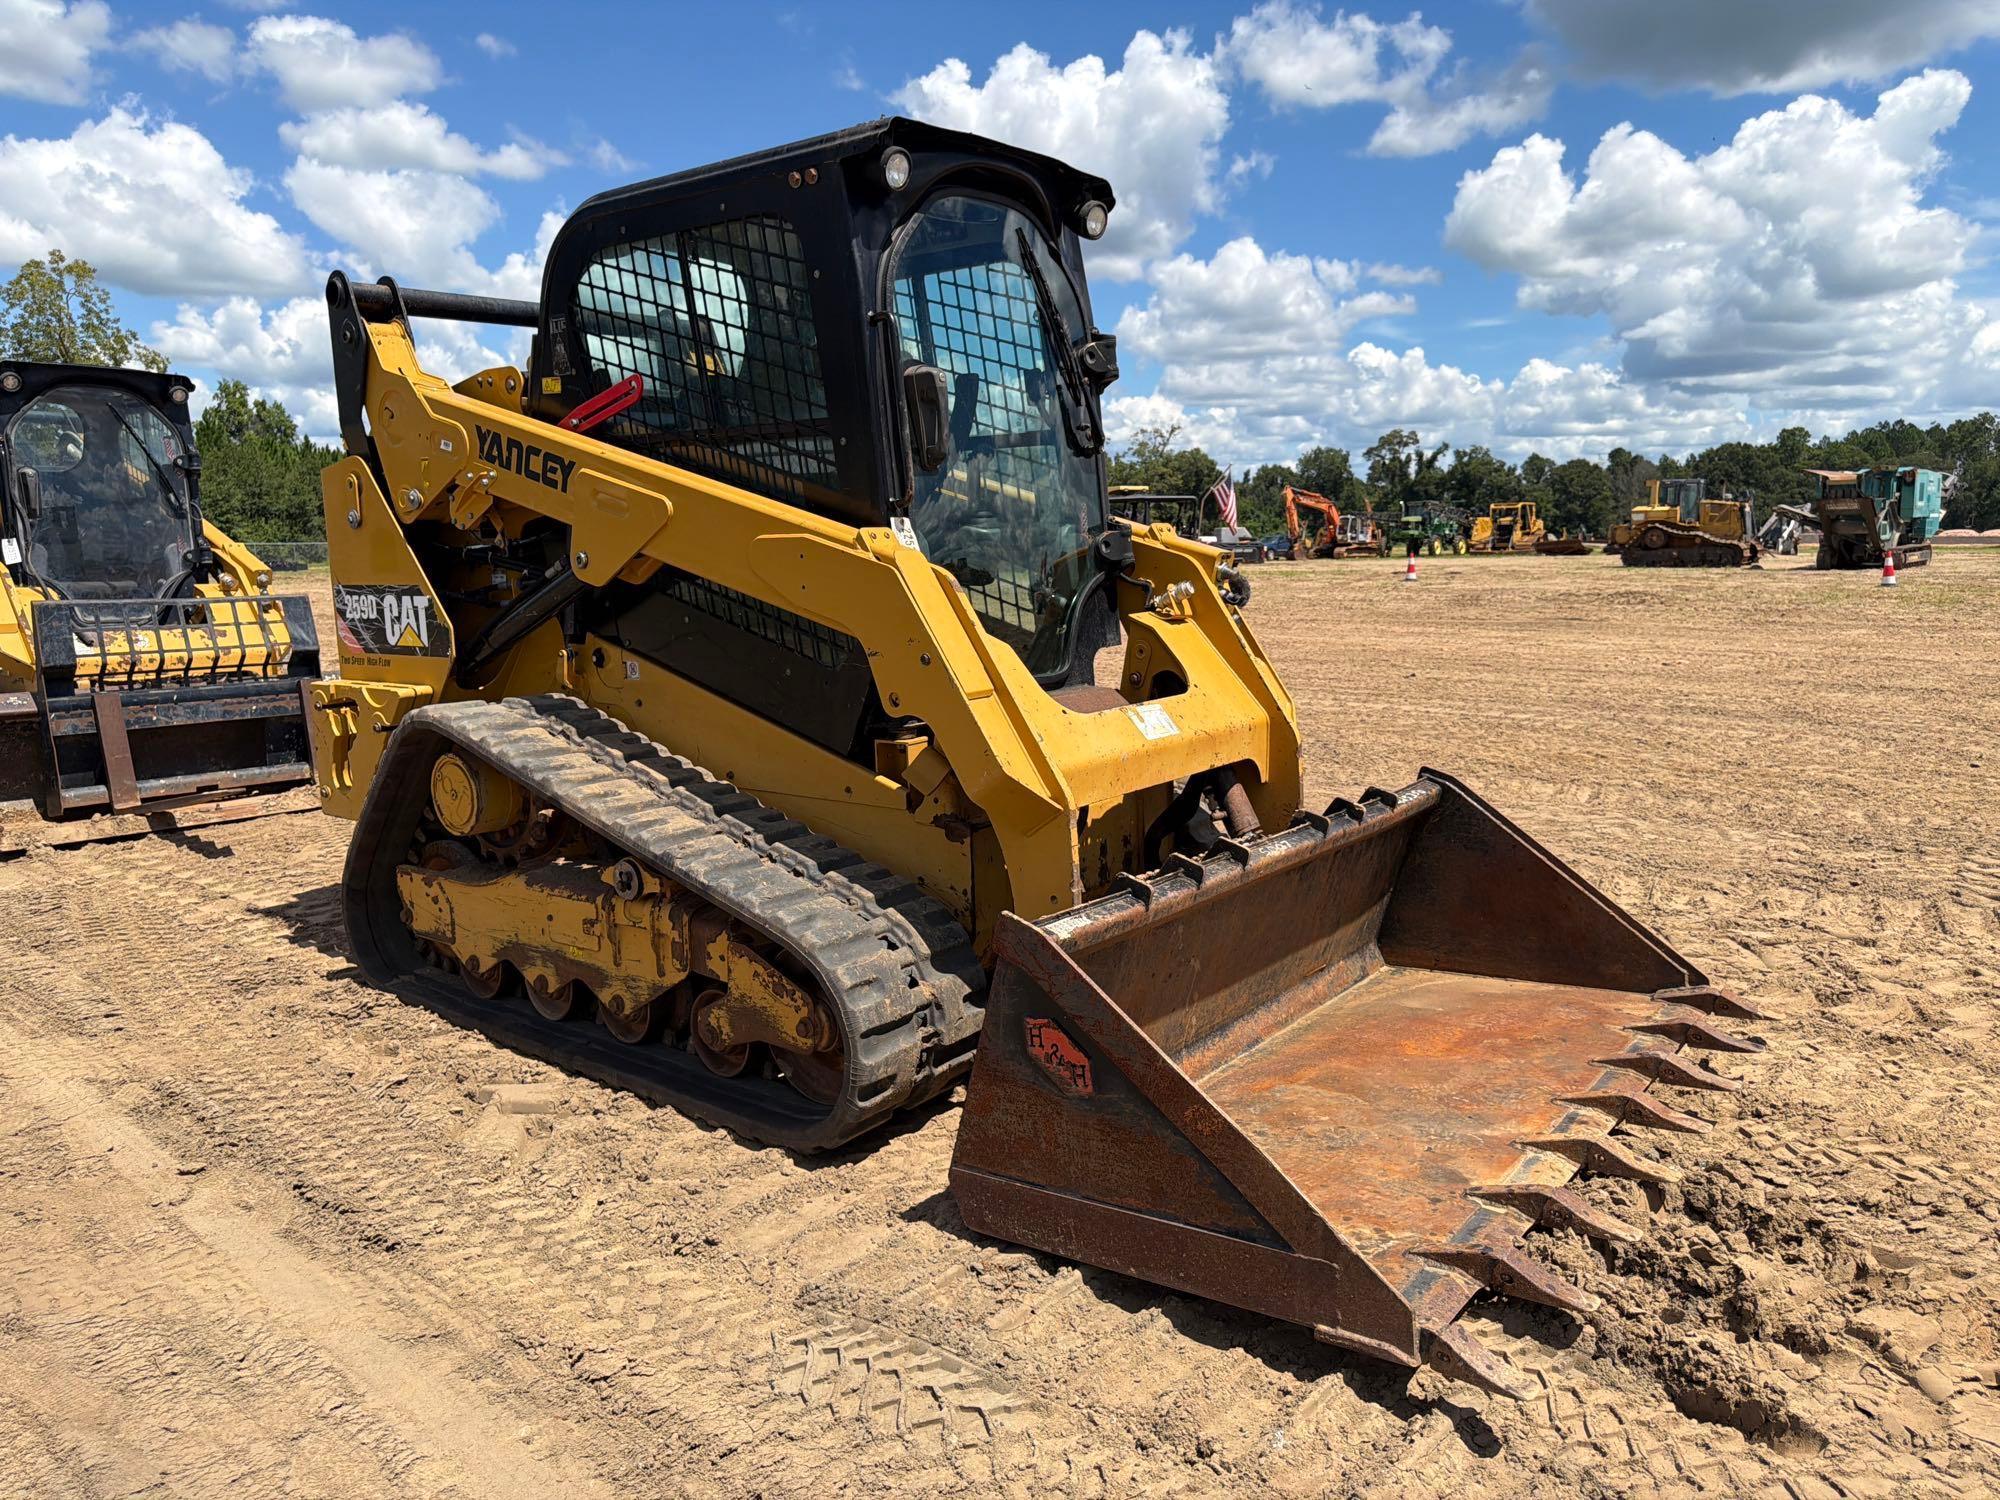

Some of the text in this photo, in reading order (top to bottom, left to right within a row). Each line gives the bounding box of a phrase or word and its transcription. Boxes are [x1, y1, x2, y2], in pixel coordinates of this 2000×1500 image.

[474, 424, 577, 494] YANCEY
[344, 594, 429, 648] 259D CAT
